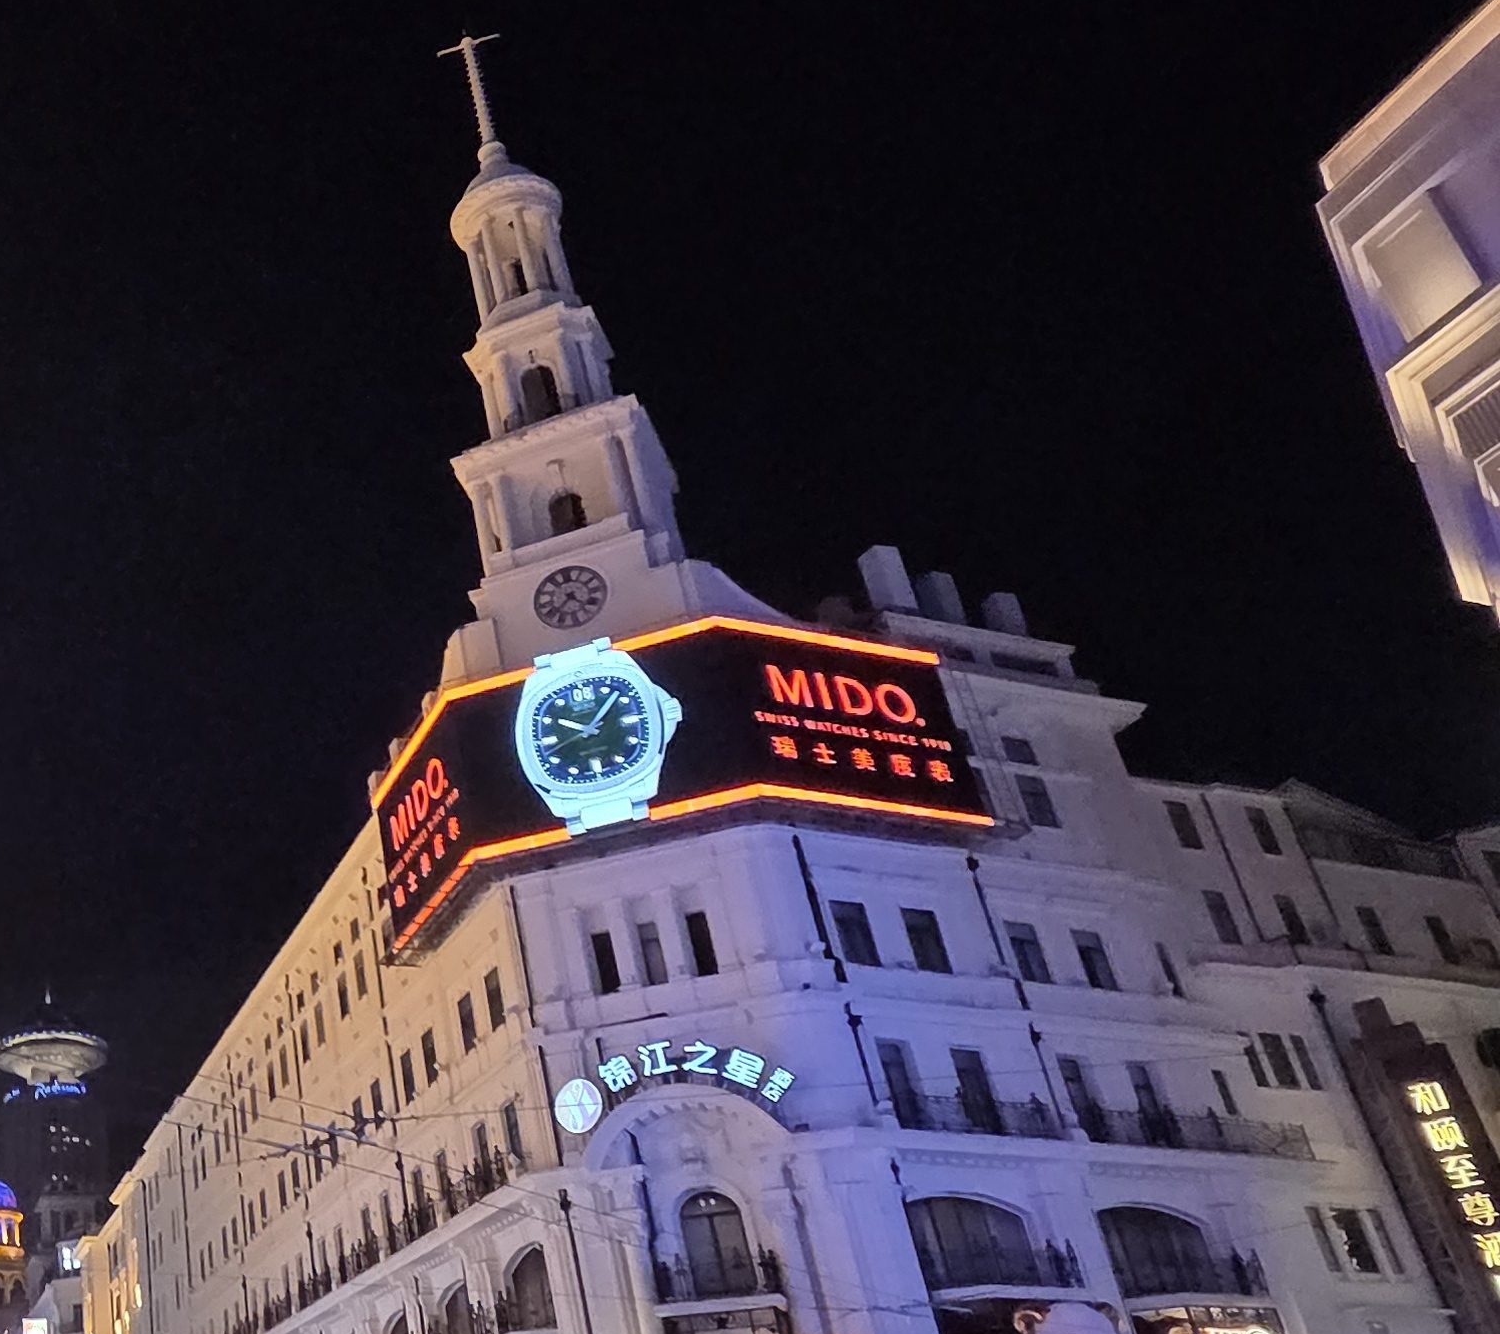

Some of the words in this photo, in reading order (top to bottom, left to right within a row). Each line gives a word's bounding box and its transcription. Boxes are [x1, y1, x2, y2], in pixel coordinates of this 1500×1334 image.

[753, 710, 800, 727] SWISS
[804, 718, 870, 739] WATCHES
[871, 729, 919, 747] SINCE
[769, 734, 955, 783] 瑞士美度表
[598, 1039, 767, 1094] 锦江之星
[1405, 1080, 1500, 1301] 和颐至尊酒
